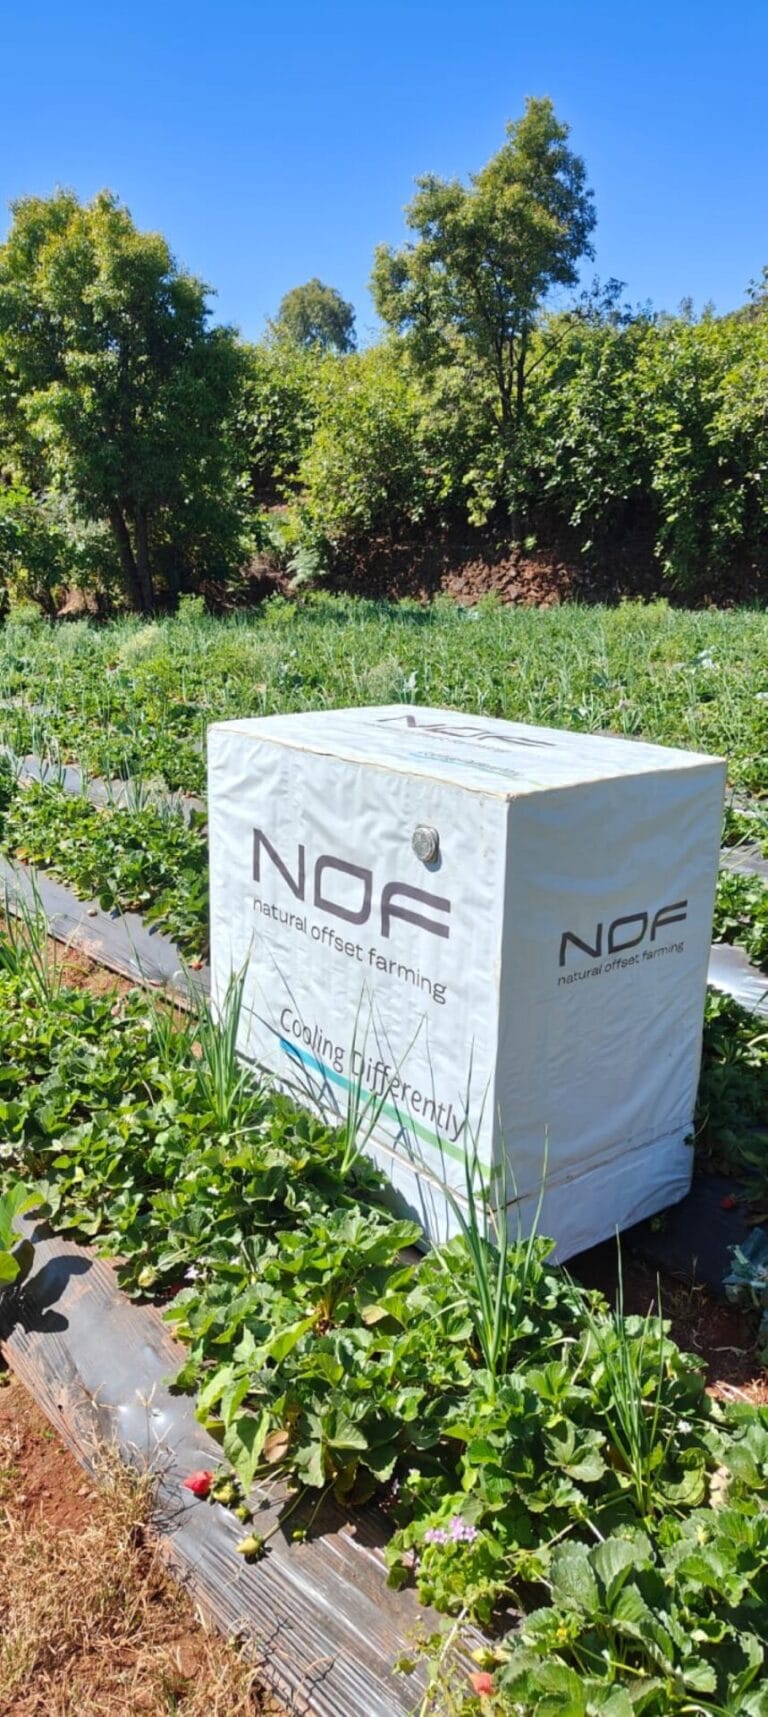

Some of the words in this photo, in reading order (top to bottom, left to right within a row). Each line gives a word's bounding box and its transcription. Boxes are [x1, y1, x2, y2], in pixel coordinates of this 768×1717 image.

[376, 714, 557, 748] NOF
[253, 827, 451, 939] NOF
[253, 898, 307, 934] natural
[311, 926, 363, 961] offset
[368, 948, 447, 1004] farming
[557, 965, 602, 986] natural
[604, 954, 640, 973] offset
[642, 941, 685, 961] farming
[559, 899, 688, 967] NOF
[280, 1008, 345, 1073] Cooling
[351, 1050, 467, 1143] Differently
